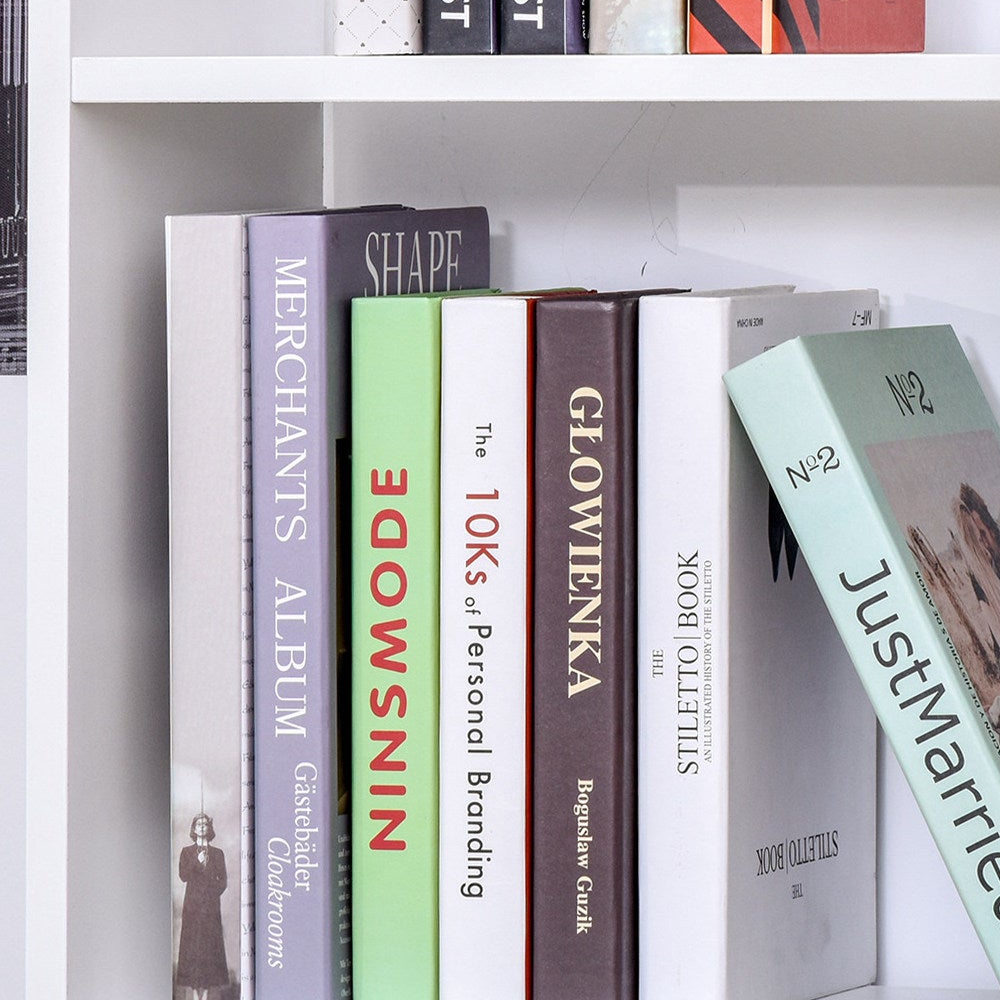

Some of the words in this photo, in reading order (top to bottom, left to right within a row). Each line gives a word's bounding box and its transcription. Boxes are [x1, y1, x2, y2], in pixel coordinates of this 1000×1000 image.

[364, 230, 463, 297] SHAPE
[852, 310, 872, 326] MF-7
[274, 256, 307, 543] MERCHANTS
[475, 422, 492, 459] The
[465, 489, 500, 586] 10Ks
[677, 549, 699, 629] BOOK
[704, 560, 712, 605] STILETTO
[915, 571, 934, 607] AMOR
[465, 596, 481, 616] of
[704, 607, 712, 625] THE
[932, 610, 942, 625] DE
[704, 628, 712, 639] OF
[274, 578, 307, 738] ALBUM
[369, 468, 408, 851] NINSMODE
[652, 649, 664, 678] THE
[704, 641, 712, 682] HISTORY
[467, 625, 492, 755] Personal
[677, 645, 699, 774] STILETTO
[972, 695, 981, 709] DE
[704, 684, 712, 747] ILLUSTRATED
[704, 749, 712, 763] AN
[295, 762, 319, 891] Gästebäder
[461, 771, 493, 899] Branding
[573, 779, 594, 869] Boguslaw
[756, 843, 784, 876] BOOK
[789, 830, 839, 867] STILETTO
[268, 837, 291, 969] Cloakrooms
[576, 875, 593, 934] Guzik
[792, 883, 804, 899] THE
